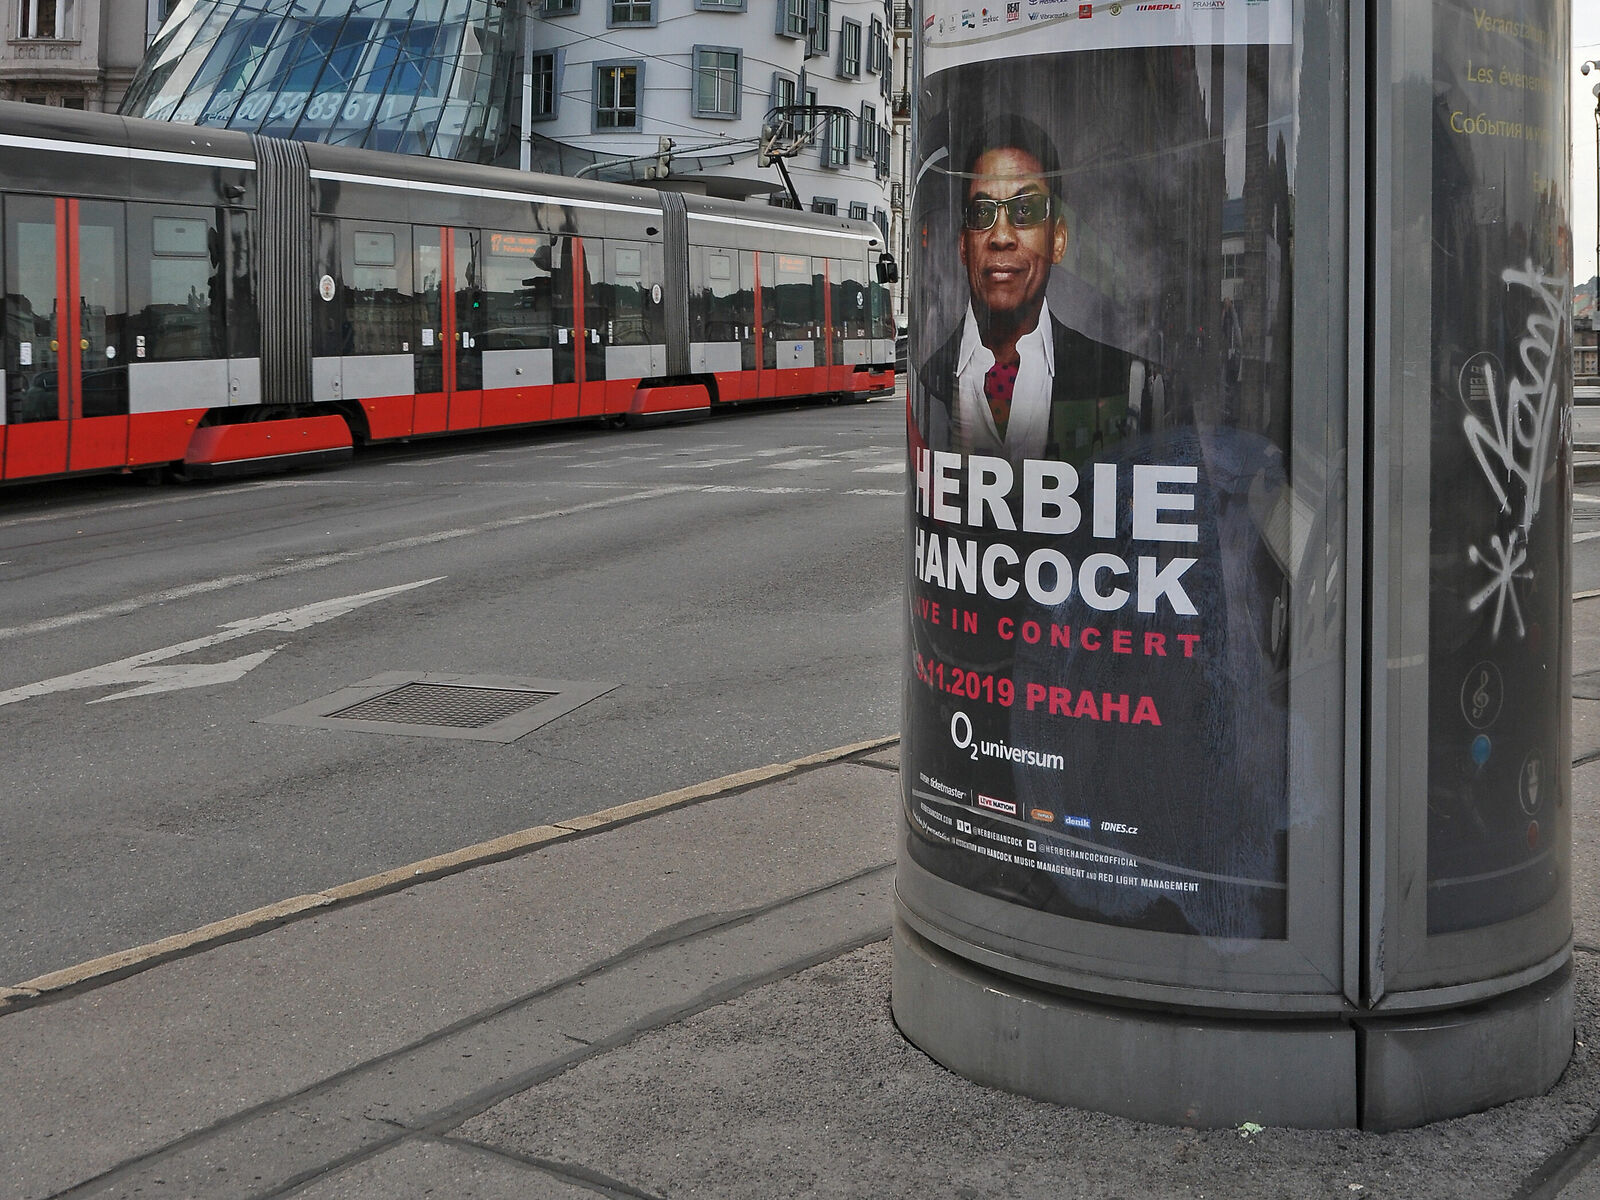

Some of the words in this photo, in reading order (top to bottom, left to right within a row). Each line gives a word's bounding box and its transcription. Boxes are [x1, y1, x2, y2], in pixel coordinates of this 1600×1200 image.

[1467, 59, 1493, 84] Les
[1450, 111, 1521, 139] События
[916, 446, 1199, 542] HERBIE
[914, 526, 1199, 616] HANCOCK
[952, 608, 978, 635] IN
[998, 616, 1200, 658] CONCERT
[1026, 683, 1162, 726] PRAHA
[981, 739, 1064, 770] universum
[993, 801, 1014, 812] NATION
[987, 847, 1013, 864] HANCOCK
[1014, 856, 1036, 868] MUSIC
[1036, 860, 1085, 878] MANAGEMENT
[1098, 872, 1114, 883] RED
[1116, 876, 1139, 886] LIGHT
[1141, 878, 1200, 892] MANAGEMENT
[1038, 843, 1139, 868] @HERBIEHANCOCKOFFICIAL
